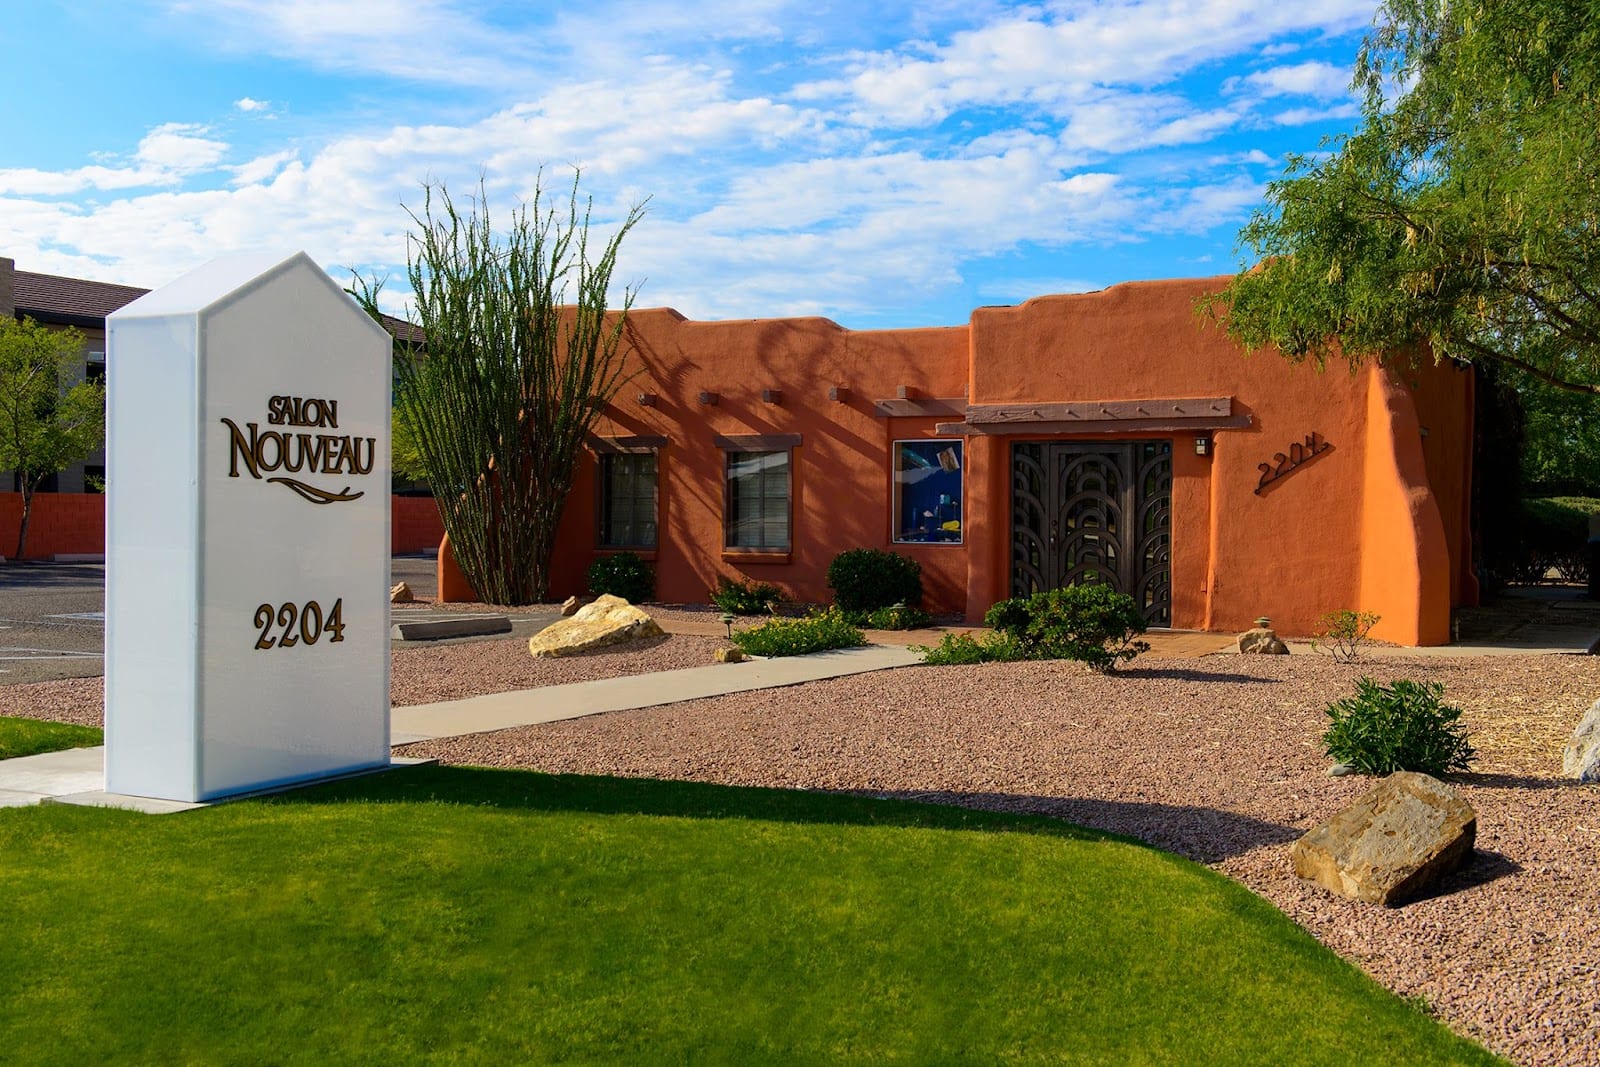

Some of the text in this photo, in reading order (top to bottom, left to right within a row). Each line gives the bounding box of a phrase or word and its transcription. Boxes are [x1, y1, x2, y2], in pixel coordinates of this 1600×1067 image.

[268, 395, 338, 428] SALON
[220, 417, 376, 479] NOUVEAU
[1256, 431, 1322, 490] 2204
[253, 598, 345, 650] 2204
